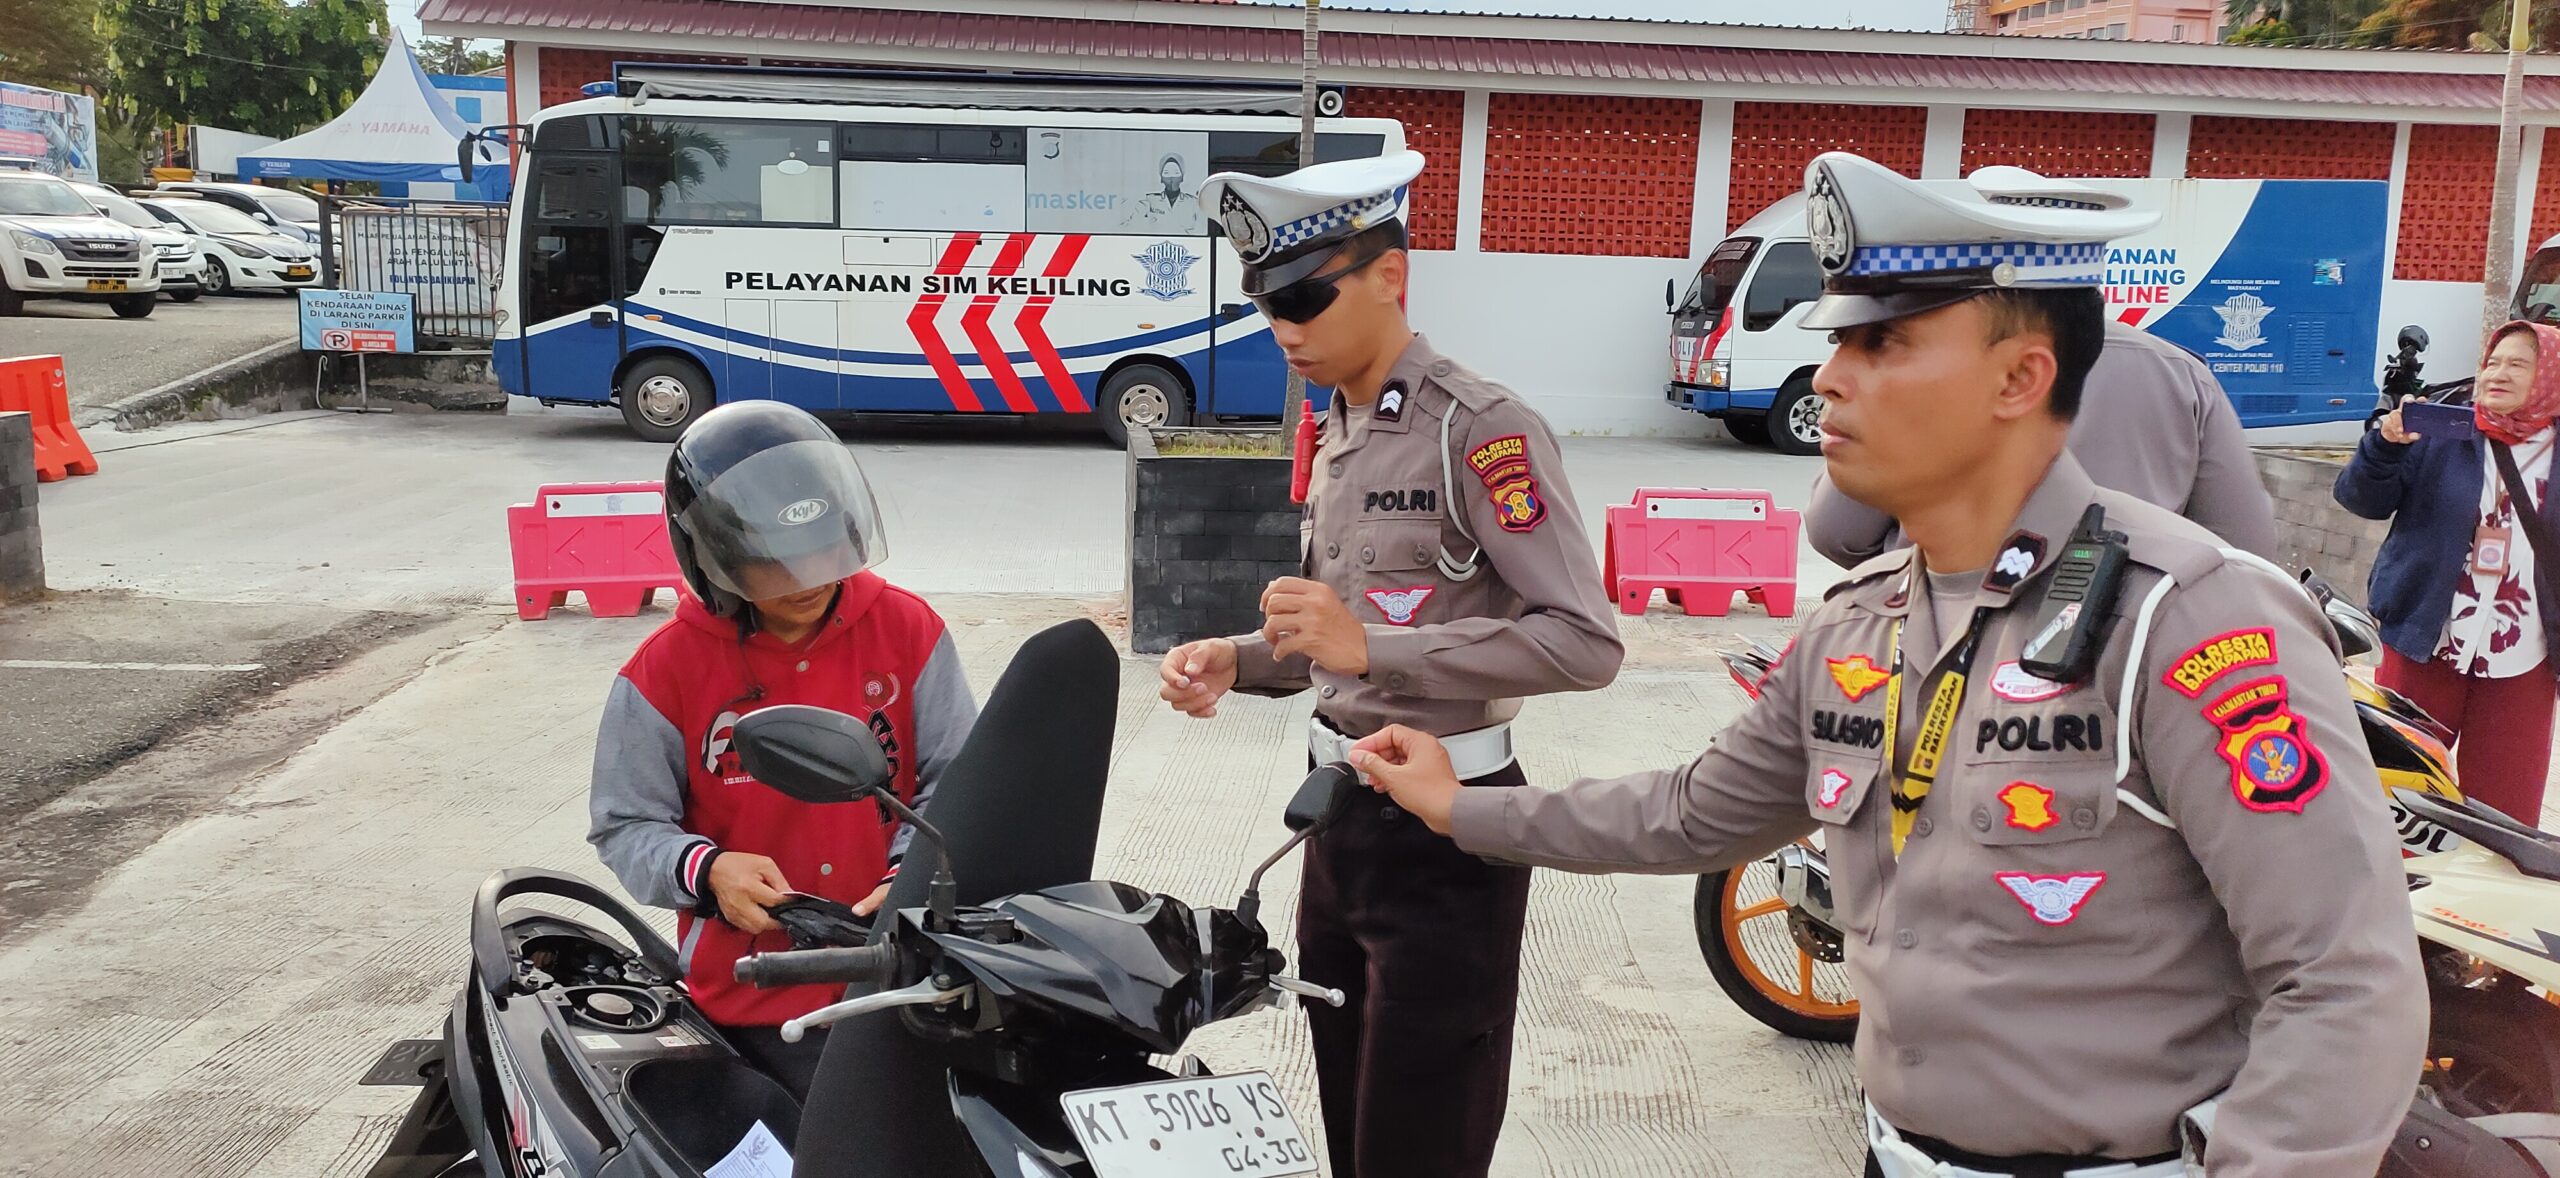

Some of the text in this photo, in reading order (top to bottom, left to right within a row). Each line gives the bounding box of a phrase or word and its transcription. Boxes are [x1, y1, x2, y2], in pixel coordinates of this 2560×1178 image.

[361, 122, 431, 135] YAMAHA
[1027, 190, 1117, 210] masker
[725, 271, 1131, 296] PELAYANAN SIM KELILING
[2102, 269, 2185, 285] LILING
[307, 300, 407, 311] KENDARAAN DINAS
[339, 292, 375, 300] SELAIN
[323, 311, 366, 320] LARANG
[368, 313, 405, 321] PARKIR
[354, 321, 375, 329] SINI
[1471, 438, 1522, 464] POLRESTA
[1363, 489, 1436, 512] POLRI
[2173, 632, 2269, 682] POLRESTA
[2184, 645, 2270, 691] BALIKPAPAN
[1920, 687, 1948, 751] POLRESTA
[1929, 677, 1959, 755] BALIKPAPAN
[1976, 713, 2103, 754] POLRI
[1075, 1082, 1285, 1145] KT 5906 YS
